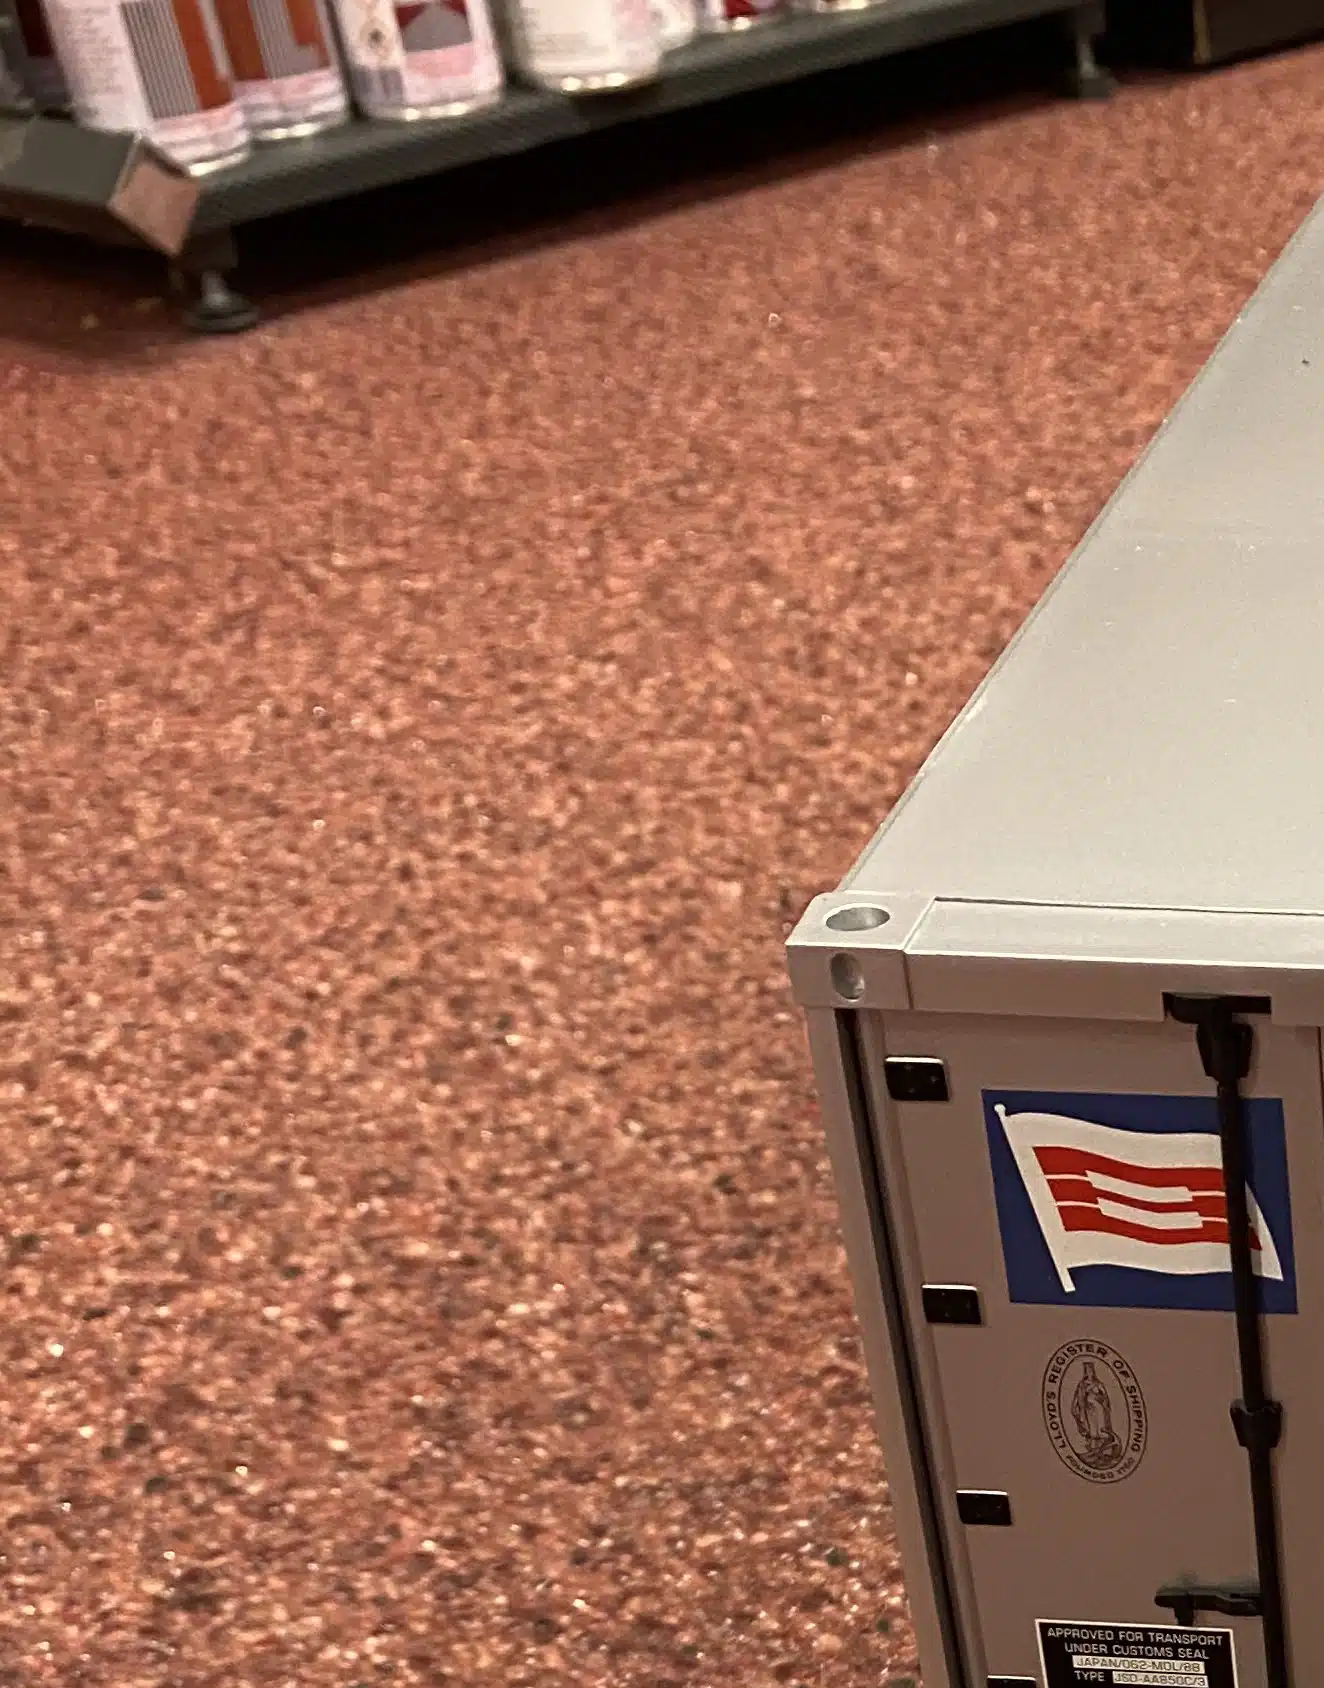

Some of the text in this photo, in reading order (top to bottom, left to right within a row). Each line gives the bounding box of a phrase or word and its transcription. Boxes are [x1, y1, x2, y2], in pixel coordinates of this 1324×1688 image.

[1046, 1343, 1145, 1452] LLOYD'S REGISTER OF SHIPPING
[1047, 1627, 1223, 1646] APPROVED FOR TRANSPORT
[1064, 1642, 1210, 1660] UNDER CUSTOMS SEAL
[1074, 1670, 1105, 1682] TYPE
